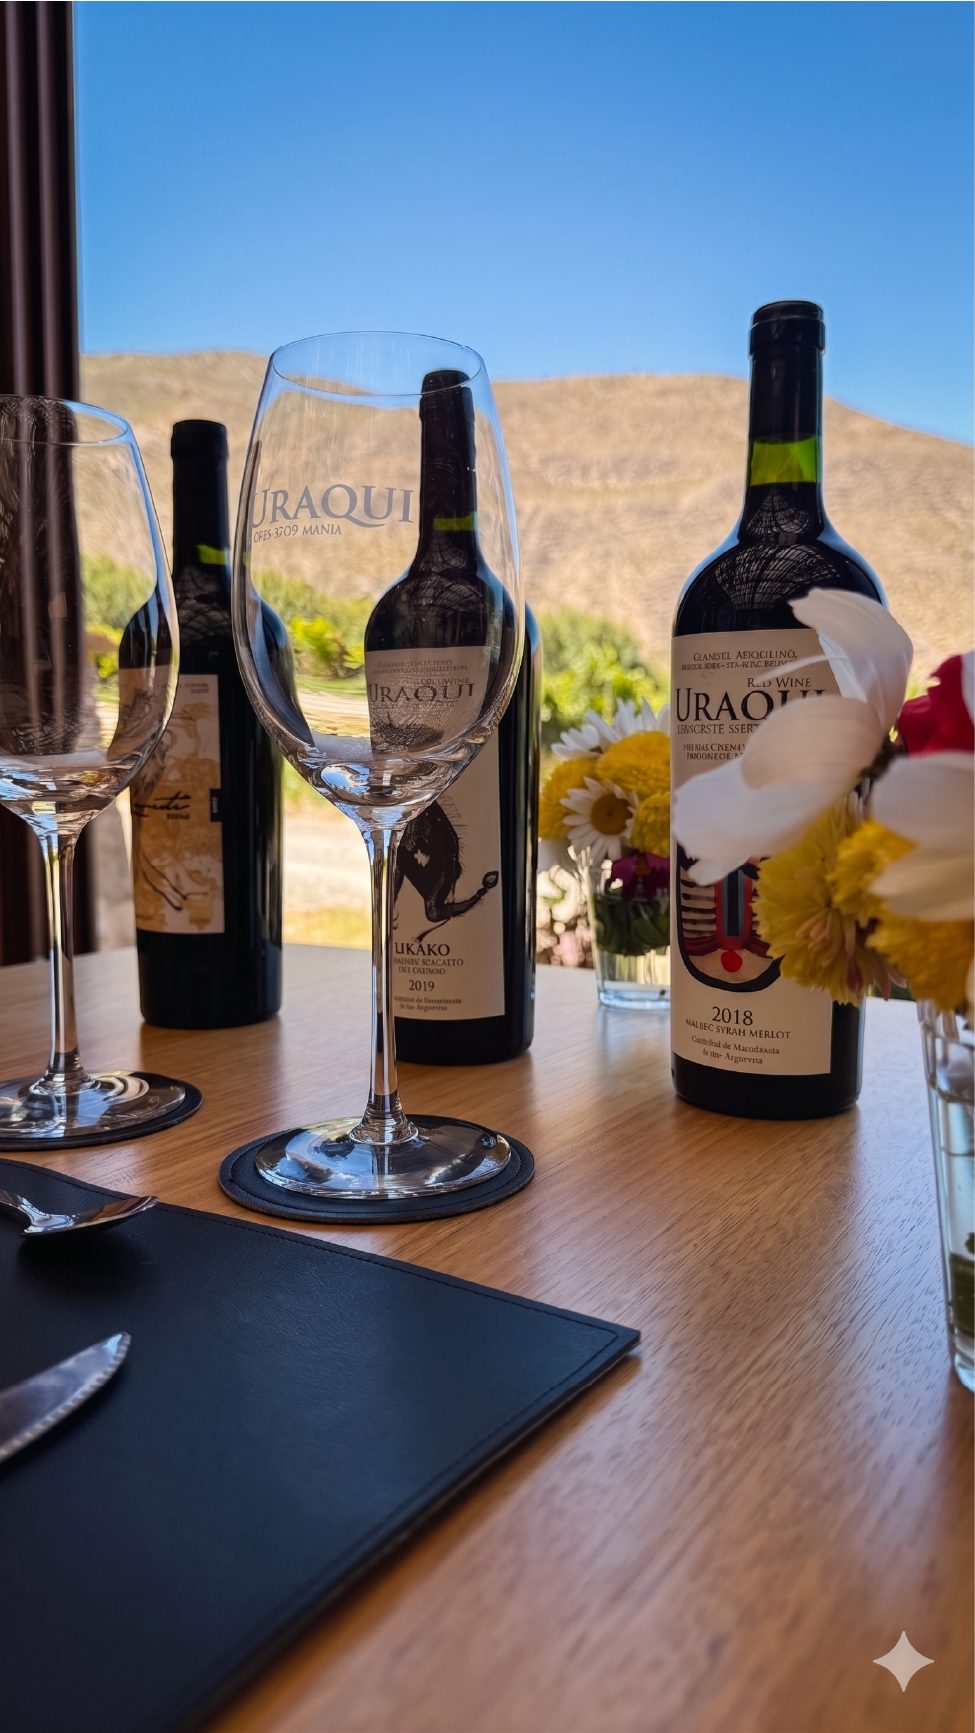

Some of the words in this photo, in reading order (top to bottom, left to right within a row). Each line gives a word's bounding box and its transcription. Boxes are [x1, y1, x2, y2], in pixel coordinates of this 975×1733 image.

[250, 484, 414, 528] URAQUI
[302, 523, 342, 536] MANIA
[747, 677, 772, 688] RD
[776, 677, 812, 688] WINE
[408, 979, 435, 992] 2019
[712, 1006, 753, 1026] 2018
[685, 1018, 715, 1032] MALBEC
[716, 1025, 746, 1037] SYRAH
[749, 1029, 792, 1040] MERLOT
